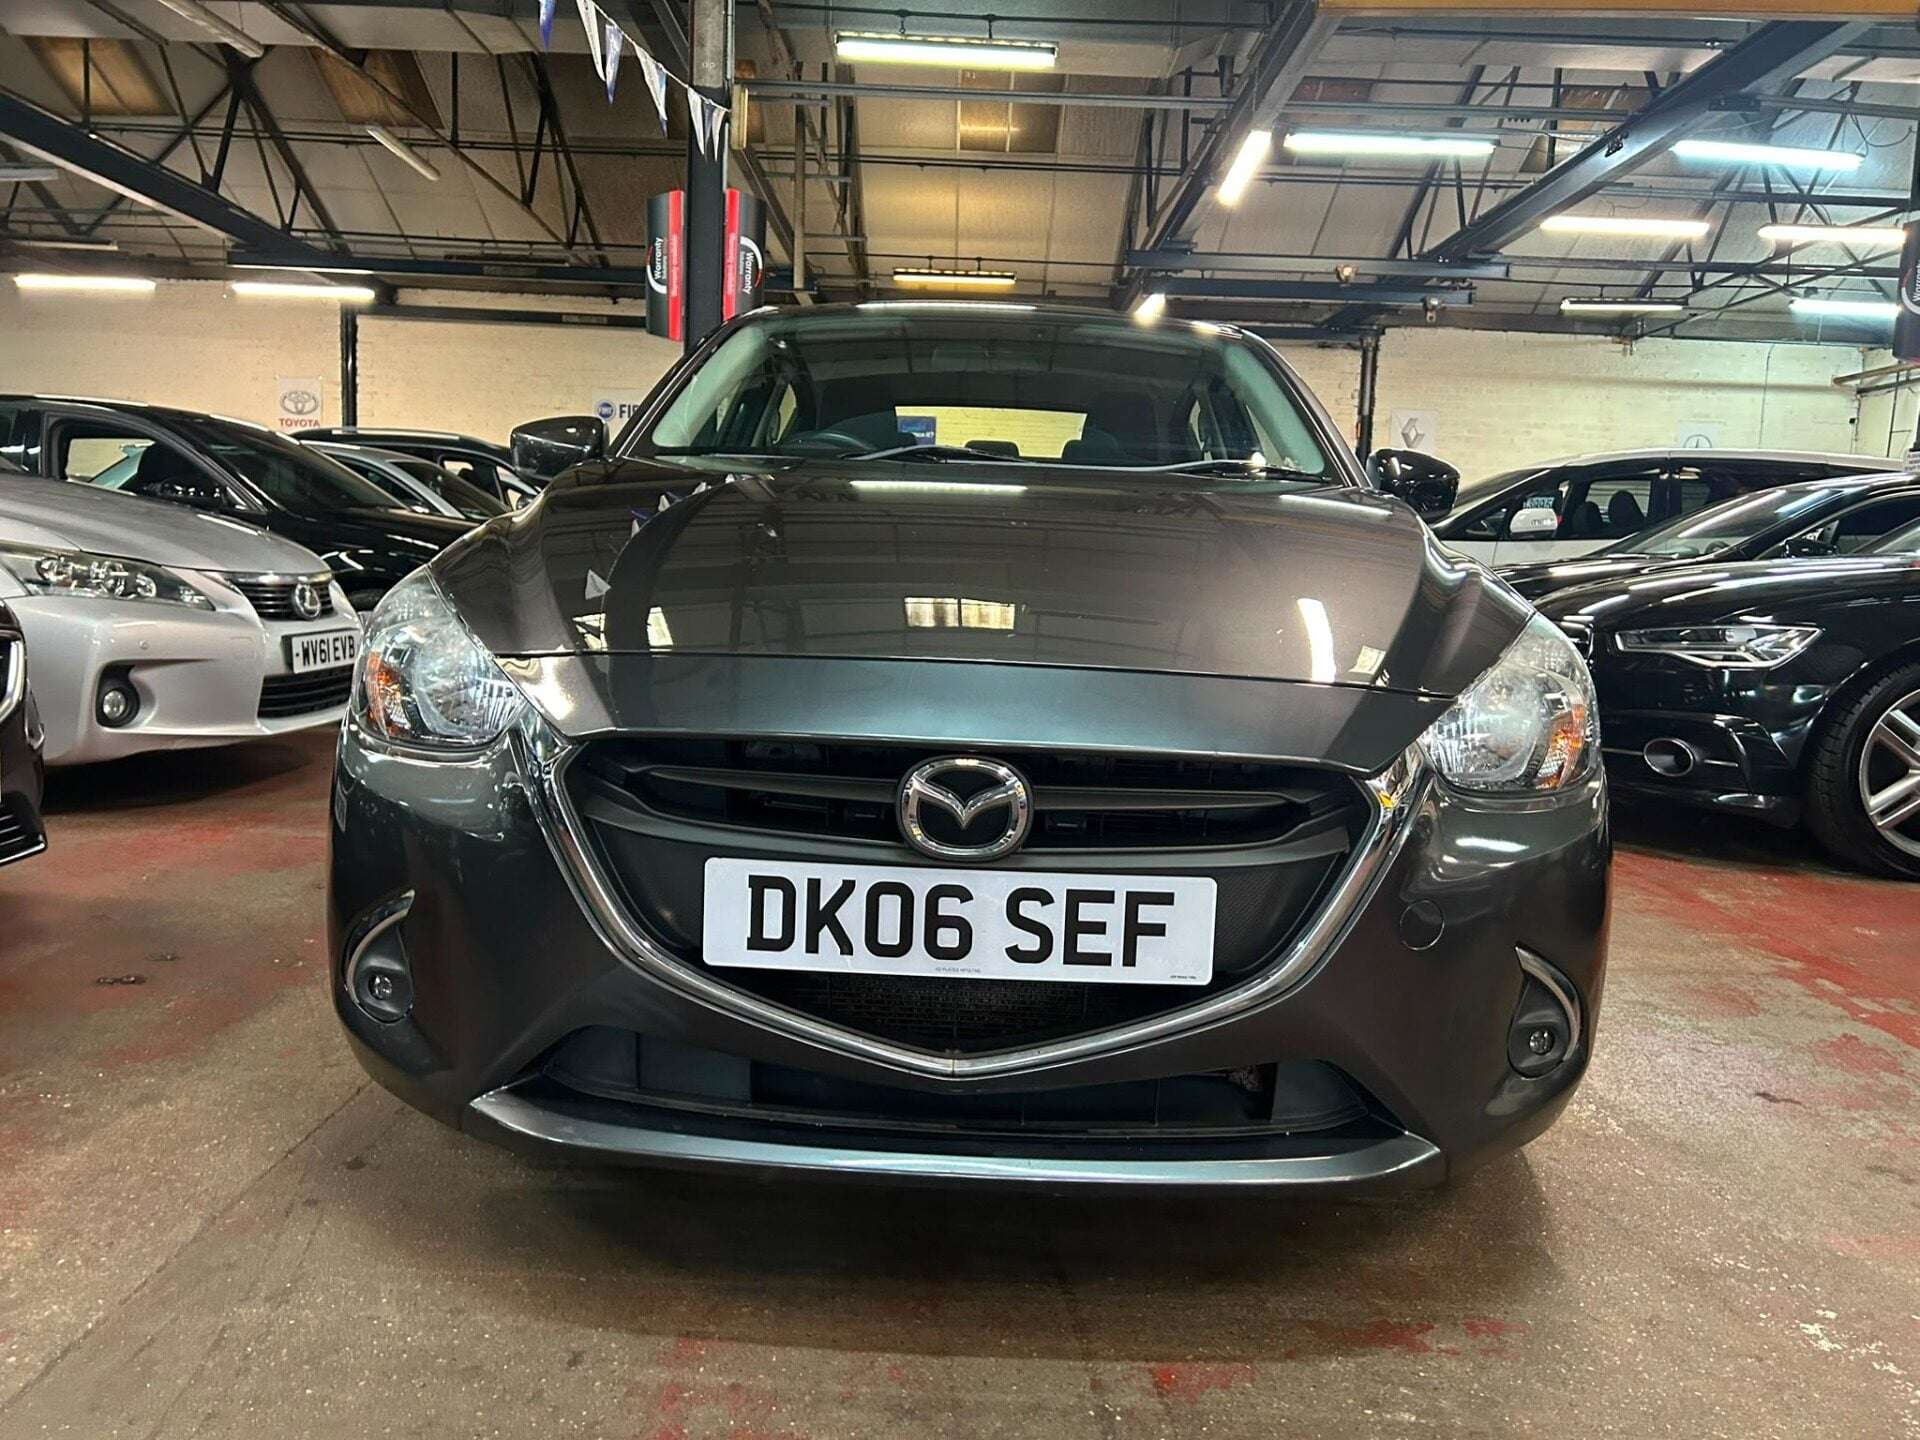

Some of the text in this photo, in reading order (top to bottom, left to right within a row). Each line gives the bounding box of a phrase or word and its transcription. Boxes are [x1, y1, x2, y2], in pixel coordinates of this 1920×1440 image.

[654, 237, 664, 280] Warranty
[742, 252, 754, 295] Warranty
[279, 417, 320, 428] TOYOTA
[301, 635, 356, 667] WV61 EVB
[747, 874, 1175, 967] DK06 SEF
